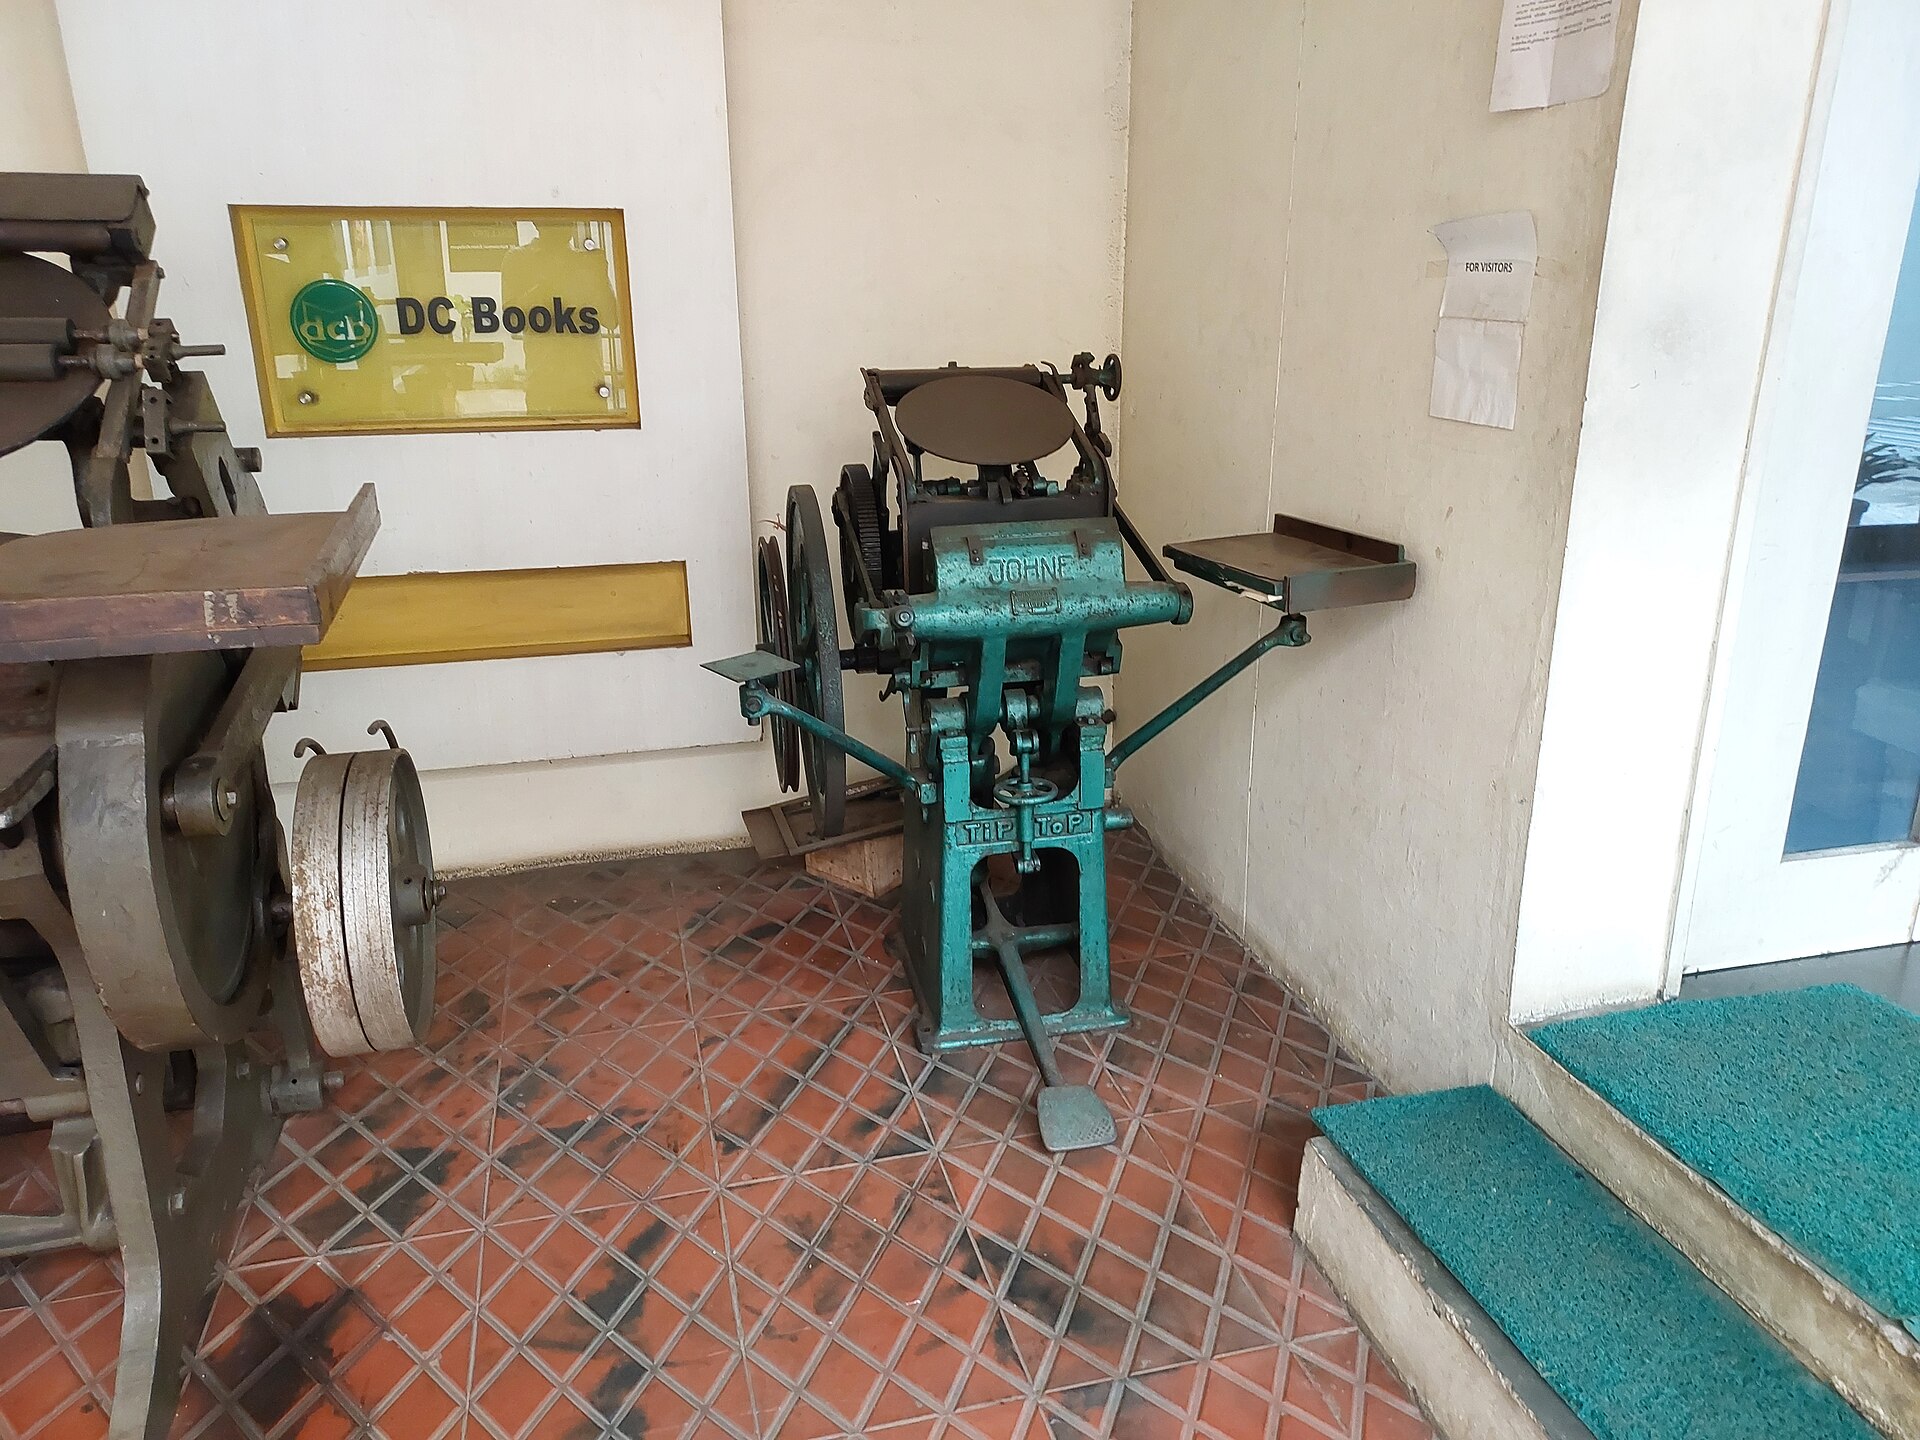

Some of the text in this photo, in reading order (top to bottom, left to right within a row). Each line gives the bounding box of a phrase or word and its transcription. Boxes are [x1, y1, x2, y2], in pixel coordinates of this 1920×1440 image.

[1465, 262, 1513, 273] FOR VISITORS
[396, 296, 600, 335] DC Books
